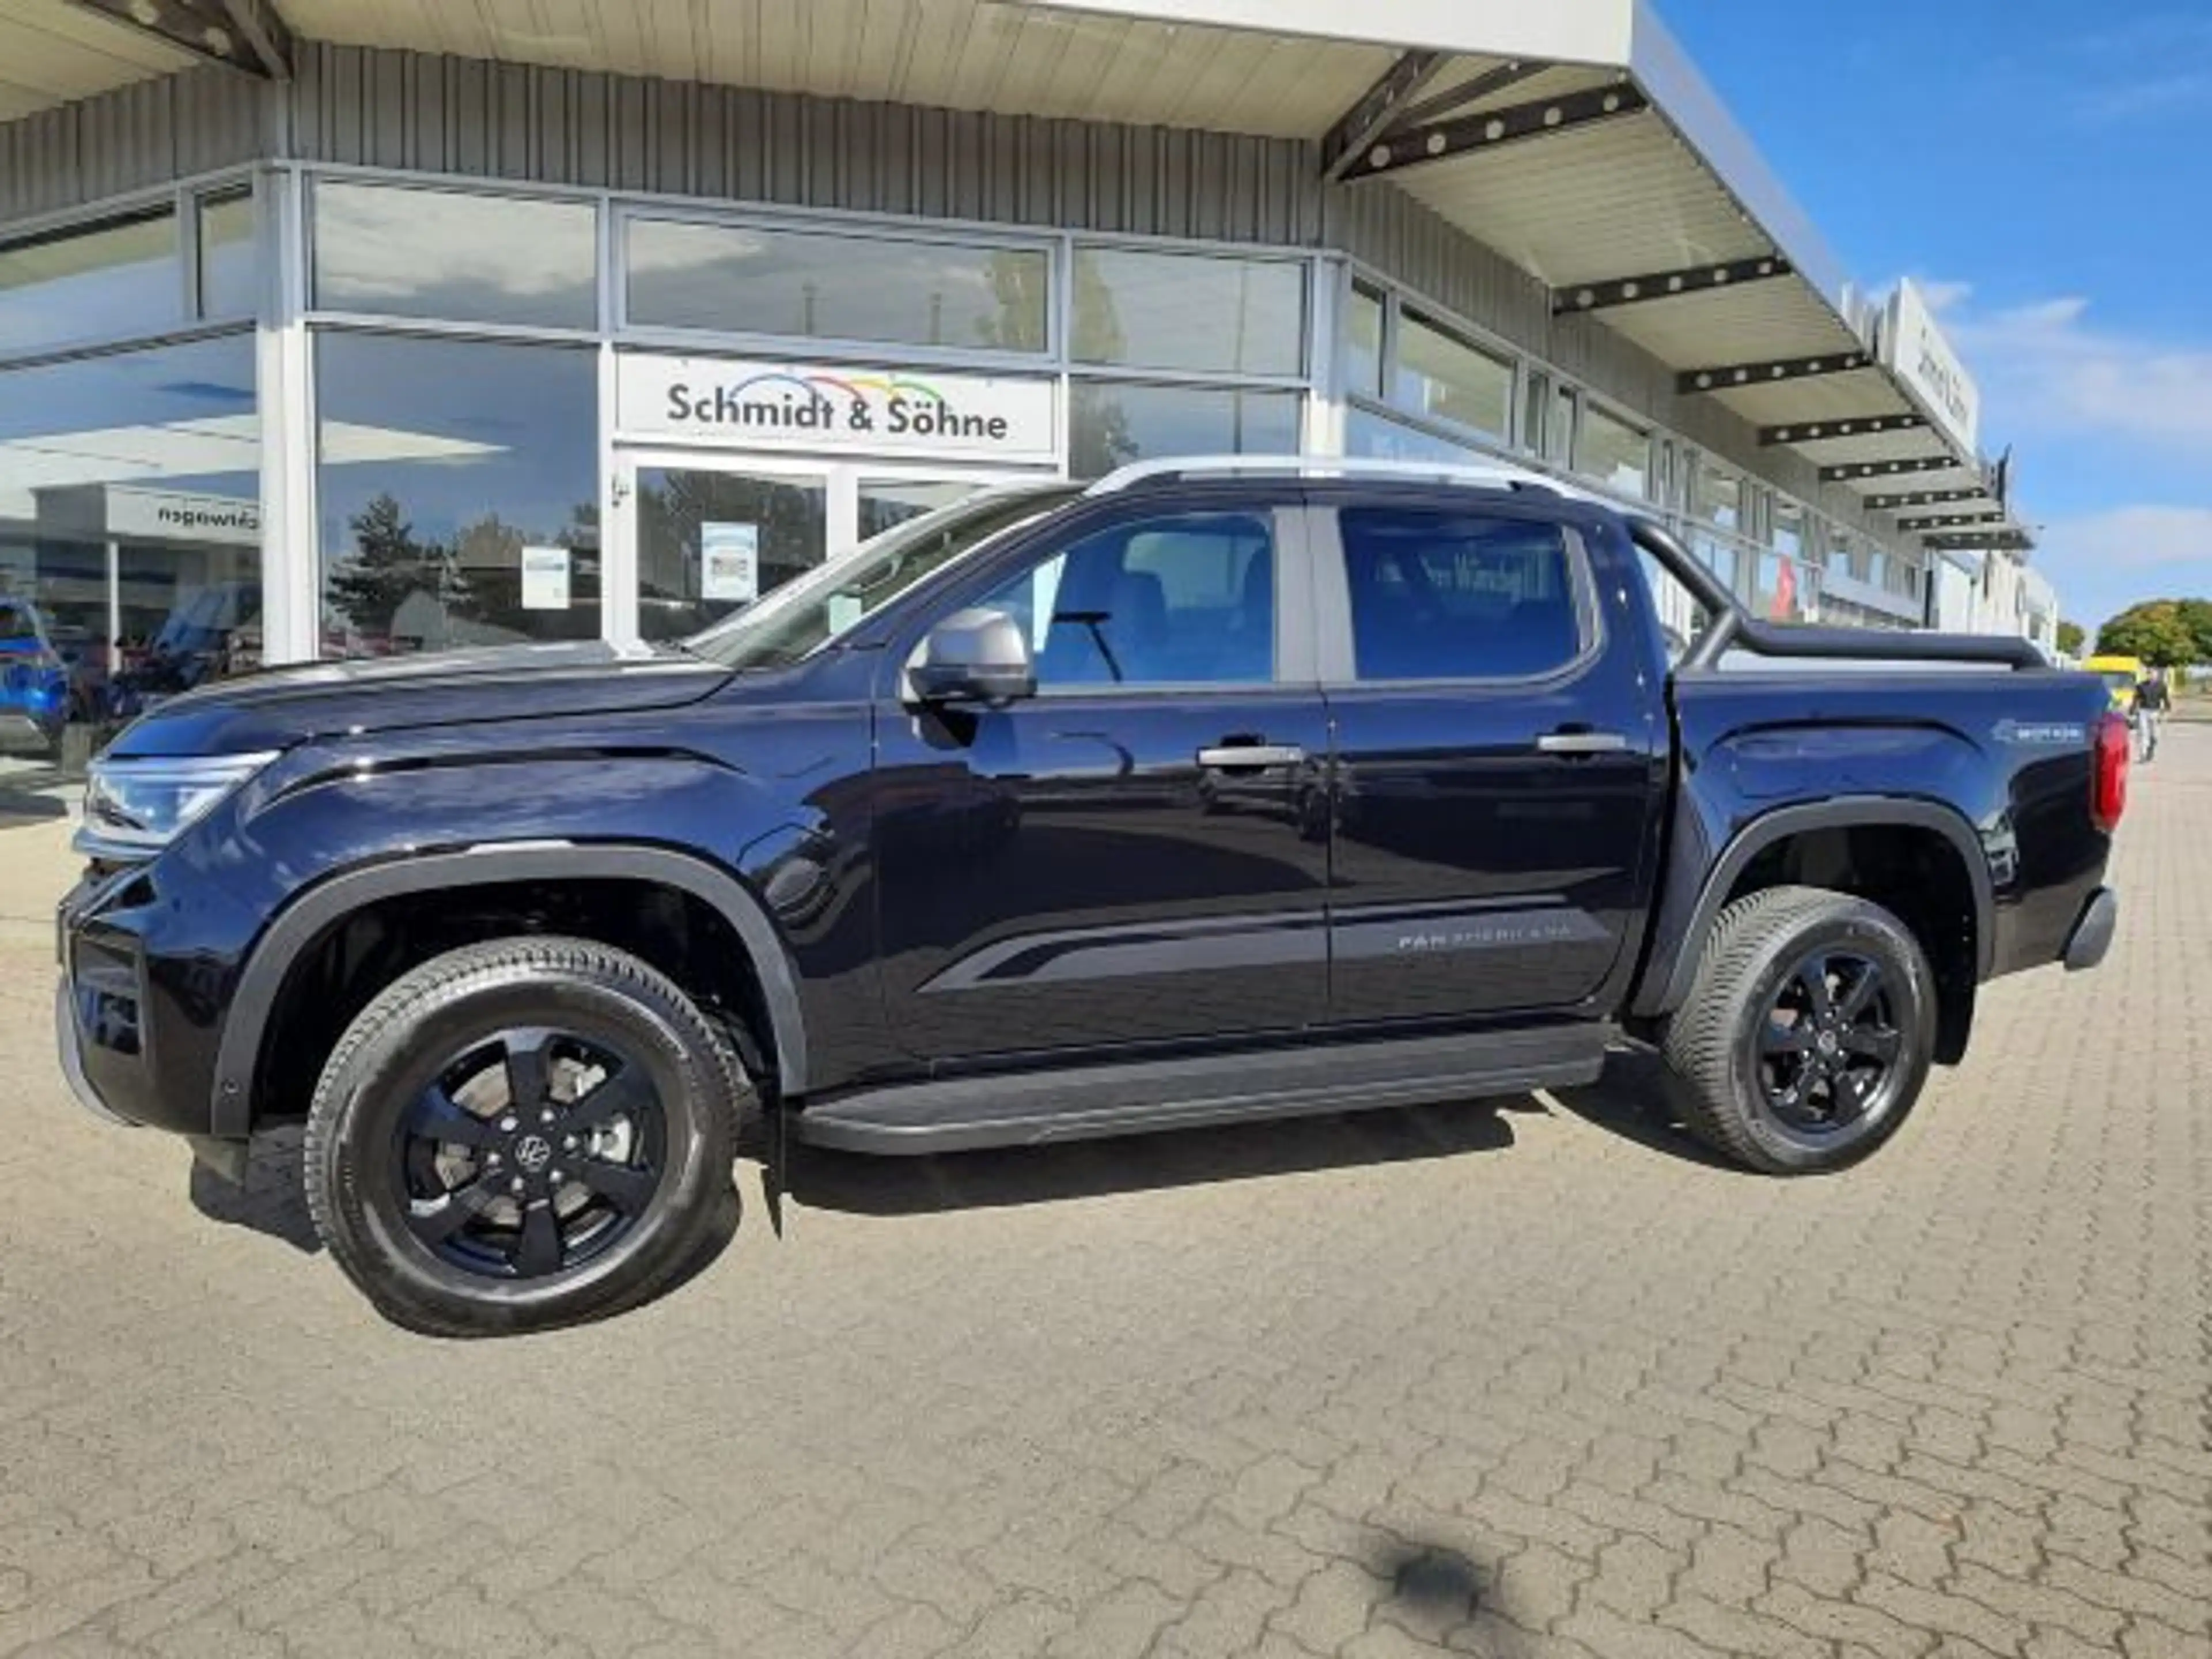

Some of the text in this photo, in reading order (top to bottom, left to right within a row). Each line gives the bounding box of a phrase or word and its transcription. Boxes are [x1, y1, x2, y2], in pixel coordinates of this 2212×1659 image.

[668, 382, 1007, 440] Schmidt & Söhne
